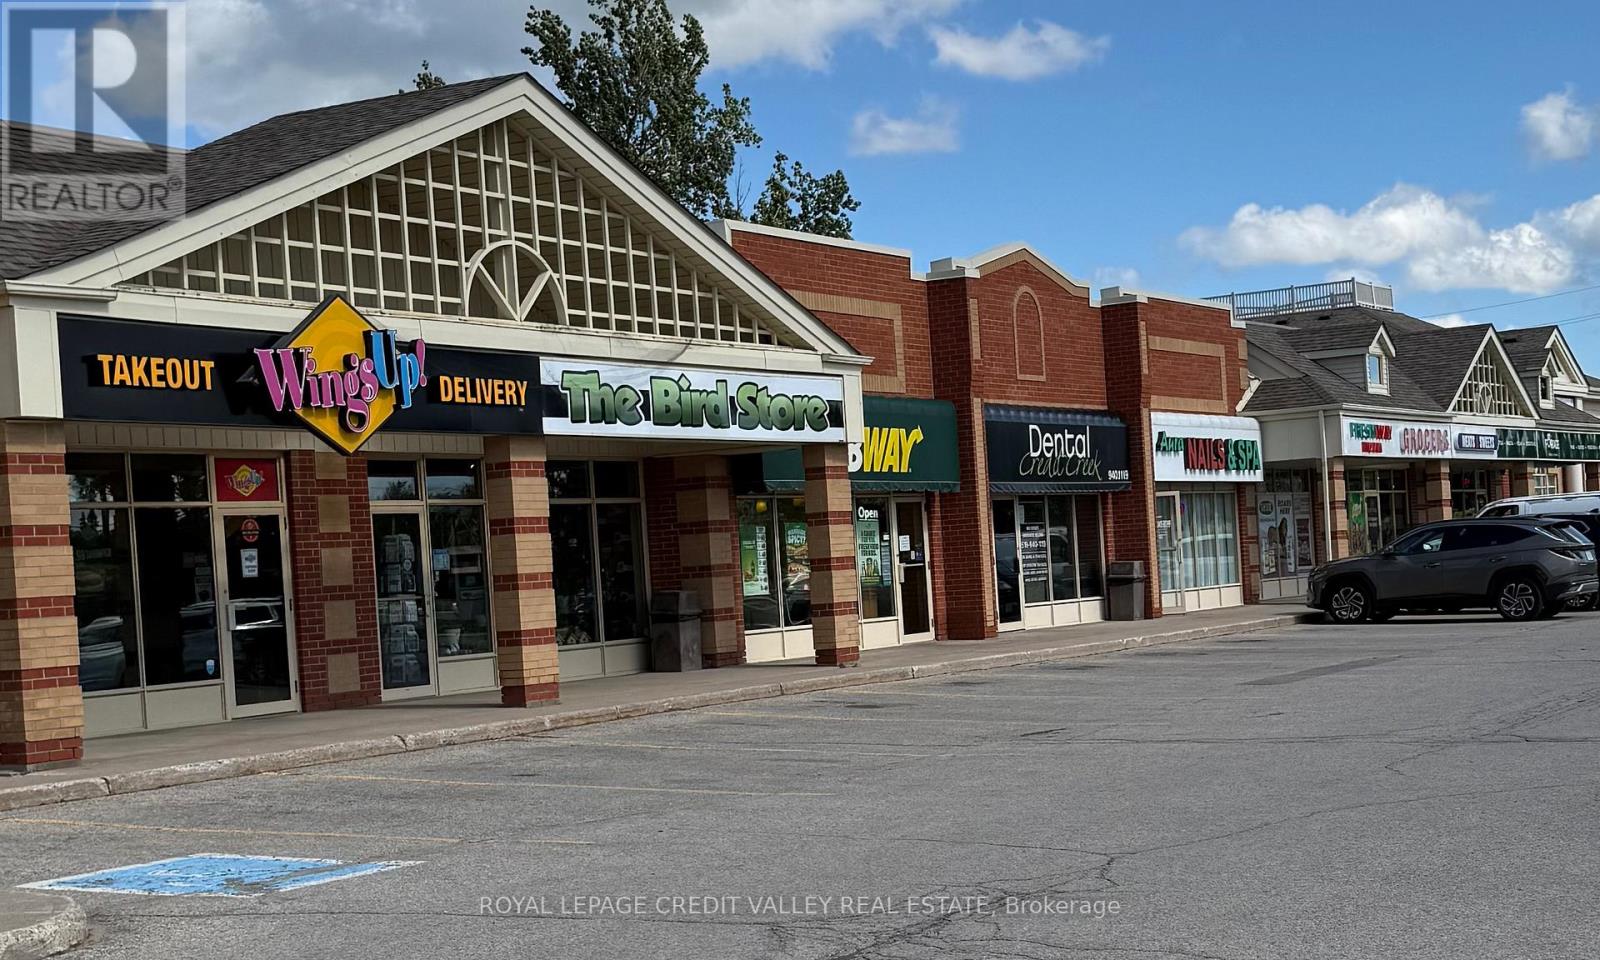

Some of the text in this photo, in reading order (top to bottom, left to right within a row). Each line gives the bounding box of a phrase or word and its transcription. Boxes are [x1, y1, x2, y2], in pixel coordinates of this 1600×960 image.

[97, 354, 215, 391] TAKEOUT
[439, 376, 528, 407] DELIVERY
[561, 370, 829, 431] The Bird Store
[848, 425, 924, 473] BWAY
[1028, 424, 1091, 458] Dental
[1185, 438, 1225, 470] NAILS
[1236, 440, 1260, 470] SPA
[1019, 449, 1102, 481] Credit Creek
[858, 506, 879, 520] Open
